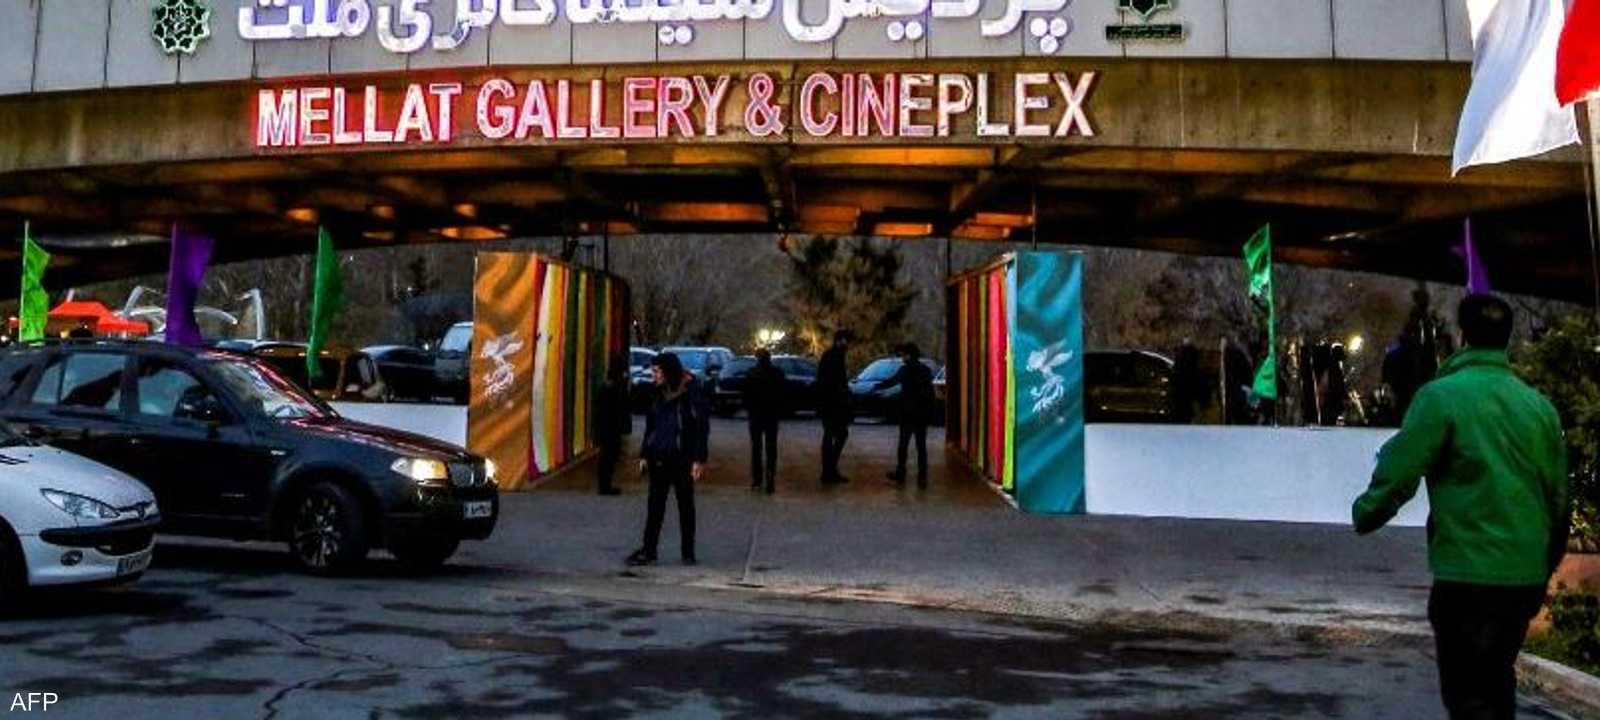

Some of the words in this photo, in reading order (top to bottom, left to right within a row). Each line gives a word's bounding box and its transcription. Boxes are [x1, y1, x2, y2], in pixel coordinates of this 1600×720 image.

[566, 0, 773, 45] سیم
[257, 82, 462, 146] MELLAT
[476, 75, 730, 139] GALLERY
[744, 73, 784, 137] &
[800, 72, 1095, 137] CINEPLEX
